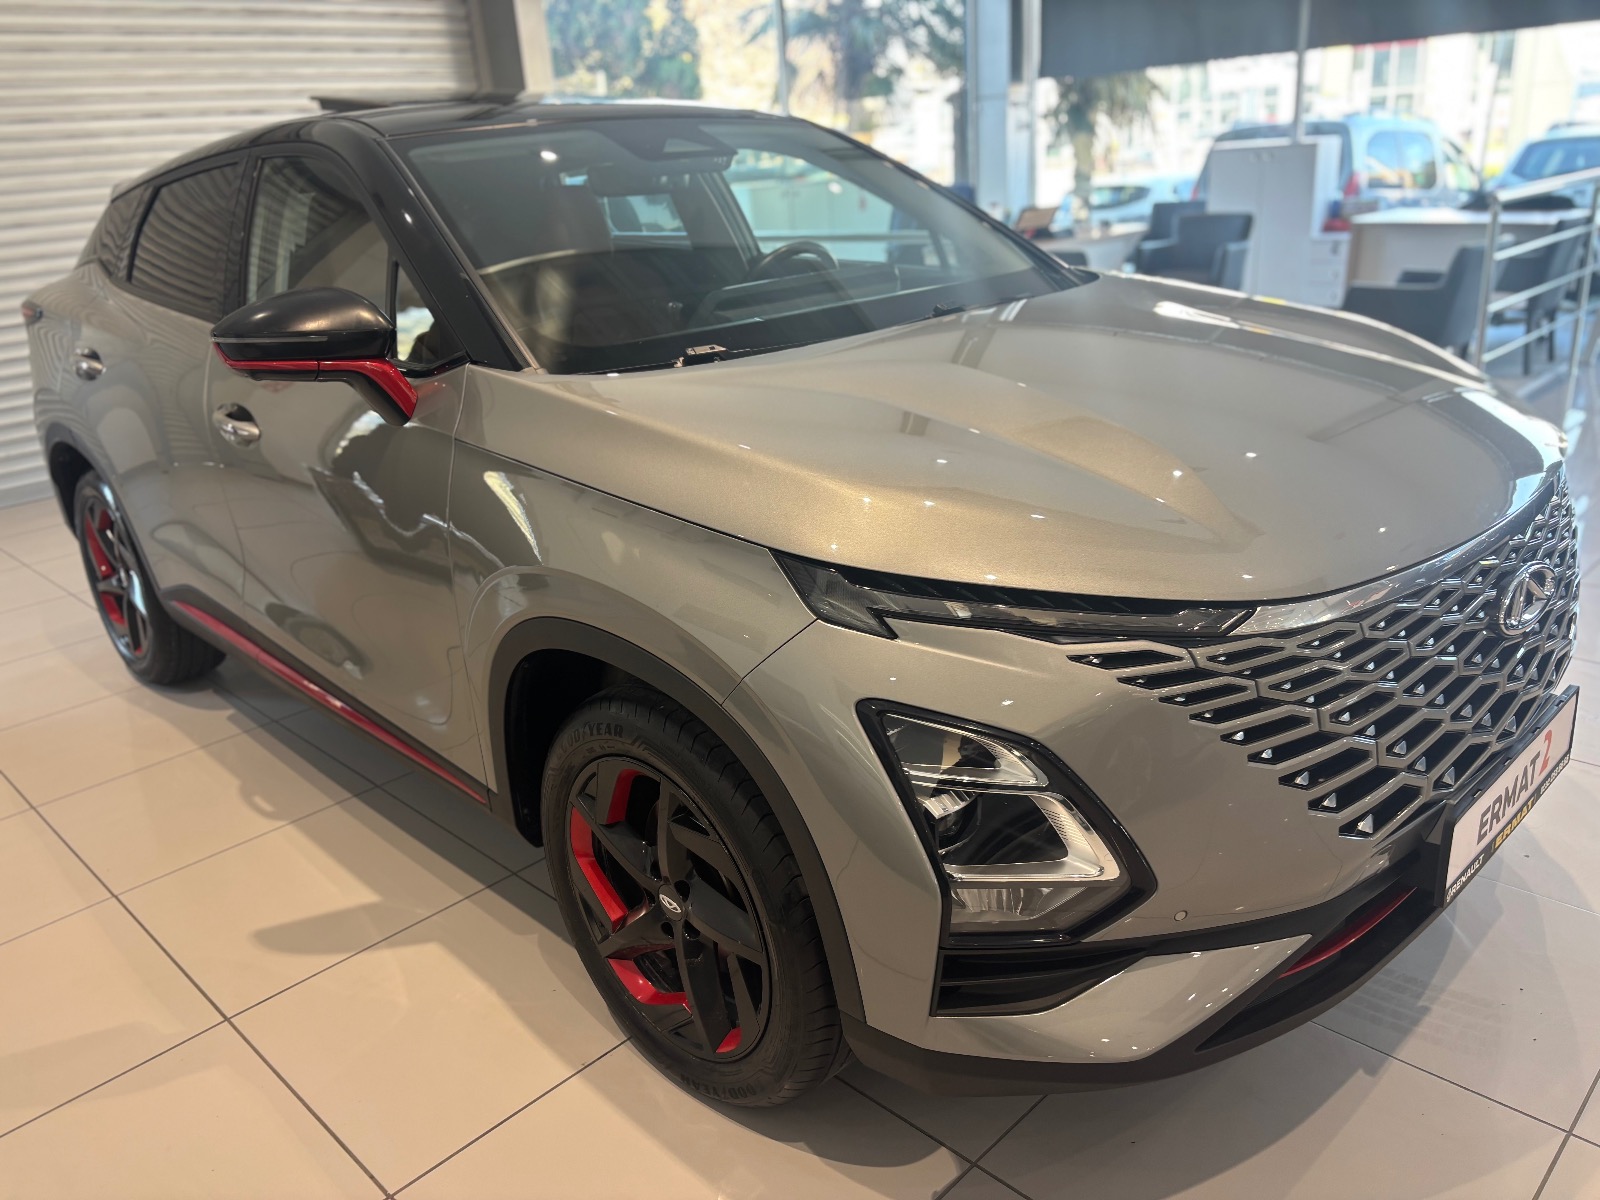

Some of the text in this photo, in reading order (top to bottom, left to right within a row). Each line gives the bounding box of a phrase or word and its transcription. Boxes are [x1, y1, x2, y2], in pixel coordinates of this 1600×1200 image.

[556, 721, 624, 758] OODYEAR
[1477, 729, 1552, 845] ERMAT 2
[1494, 799, 1536, 849] ERMAT
[1450, 853, 1485, 896] RENAULT
